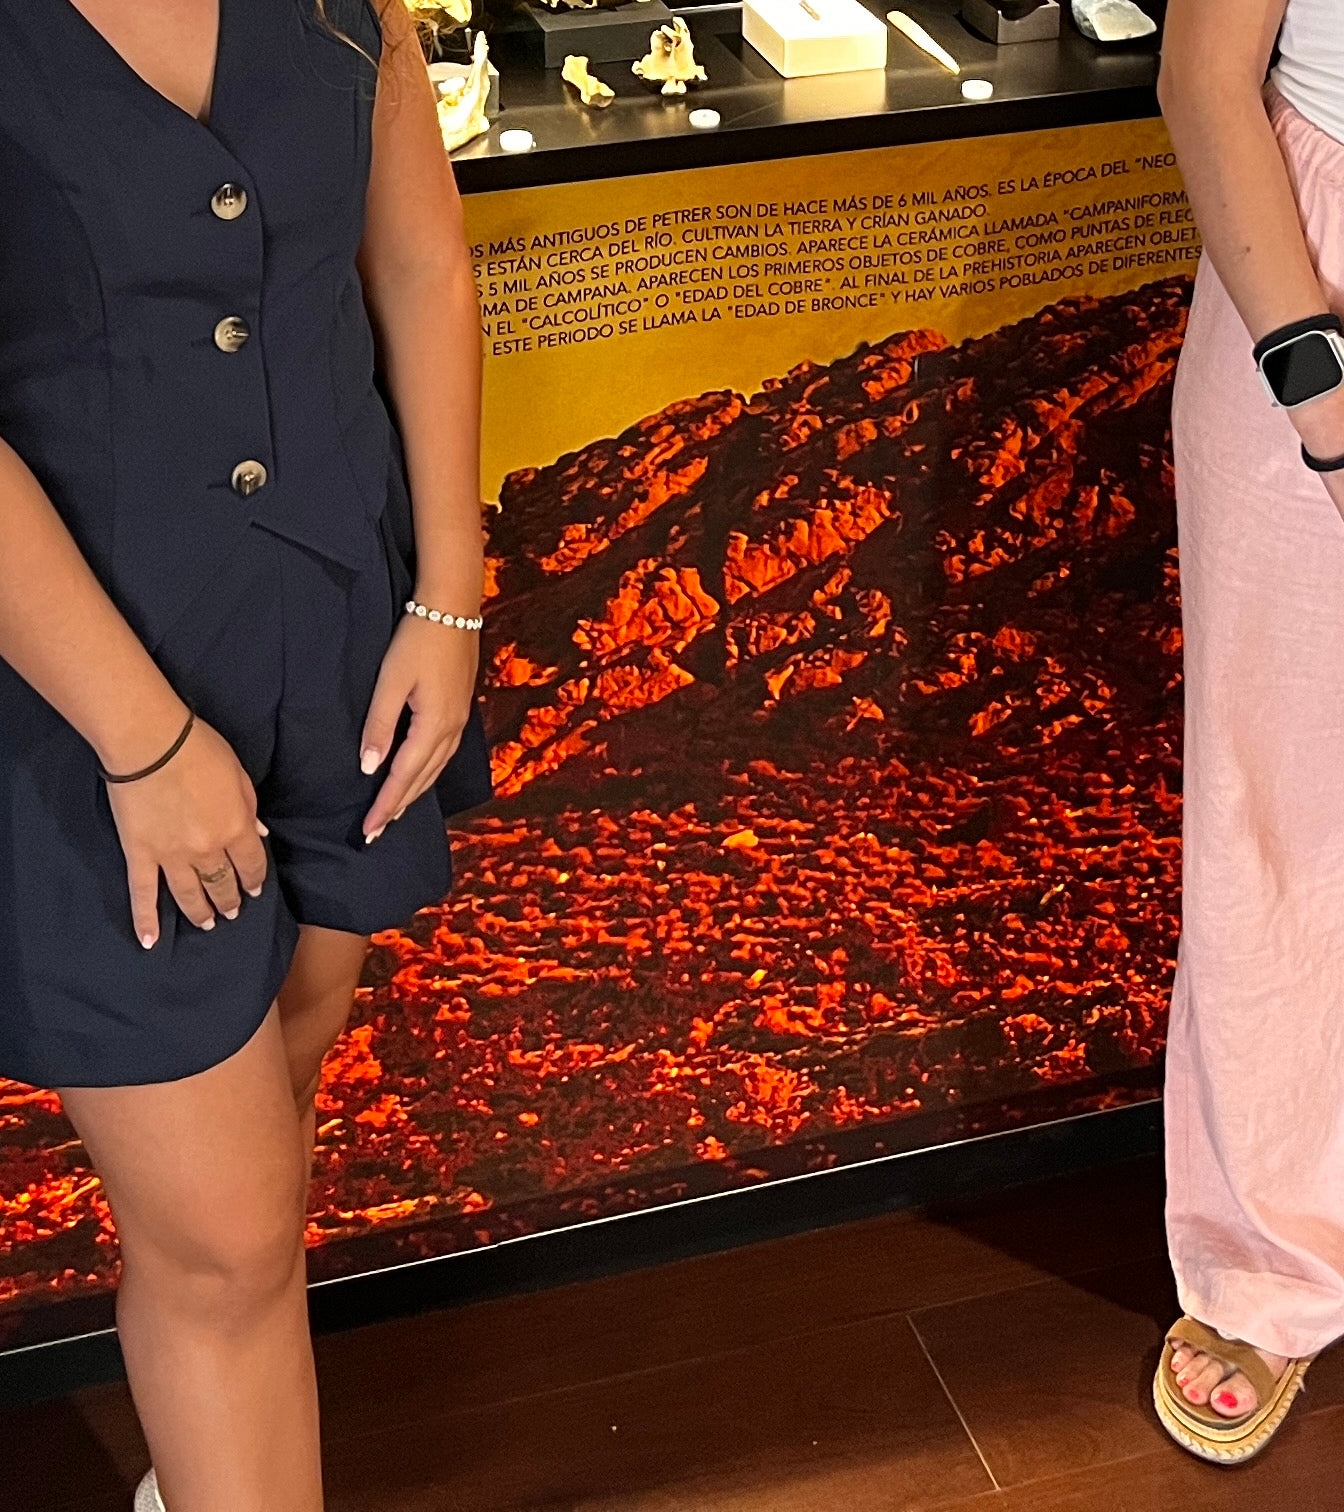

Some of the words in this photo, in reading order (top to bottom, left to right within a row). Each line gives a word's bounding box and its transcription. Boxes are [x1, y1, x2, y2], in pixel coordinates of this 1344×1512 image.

[486, 253, 542, 278] ESTÁN
[546, 245, 604, 269] CERCA
[608, 238, 641, 259] DEL
[644, 232, 678, 251] RÍO.
[680, 223, 759, 245] CULTIVAN
[764, 221, 785, 238] LA
[787, 218, 843, 236] TIERRA
[845, 216, 858, 231] Y
[860, 211, 910, 231] CRÍAN
[914, 202, 991, 226] GANADO.
[488, 235, 526, 257] MÁS
[530, 221, 620, 252] ANTIGUOS
[624, 215, 648, 235] DE
[652, 206, 712, 229] PETRER
[715, 203, 752, 221] SON
[756, 201, 779, 219] DE
[783, 198, 828, 217] HACE
[832, 194, 868, 214] MÁS
[872, 193, 894, 211] DE
[897, 193, 908, 209] 6
[911, 190, 938, 207] MIL
[942, 183, 992, 205] AÑOS.
[997, 178, 1016, 196] ES
[1020, 176, 1040, 193] LA
[1043, 165, 1098, 189] ÉPOCA
[1100, 158, 1130, 178] DEL
[492, 335, 533, 357] ESTE
[537, 322, 614, 350] PERIODO
[618, 317, 638, 336] SE
[642, 308, 698, 332] LLAMA
[701, 306, 722, 323] LA
[784, 298, 806, 316] DE
[890, 290, 902, 304] Y
[904, 285, 937, 304] HAY
[939, 278, 996, 300] VARIOS
[999, 262, 1084, 290] POBLADOS
[1088, 258, 1109, 276] DE
[1112, 244, 1203, 272] DIFERENTES
